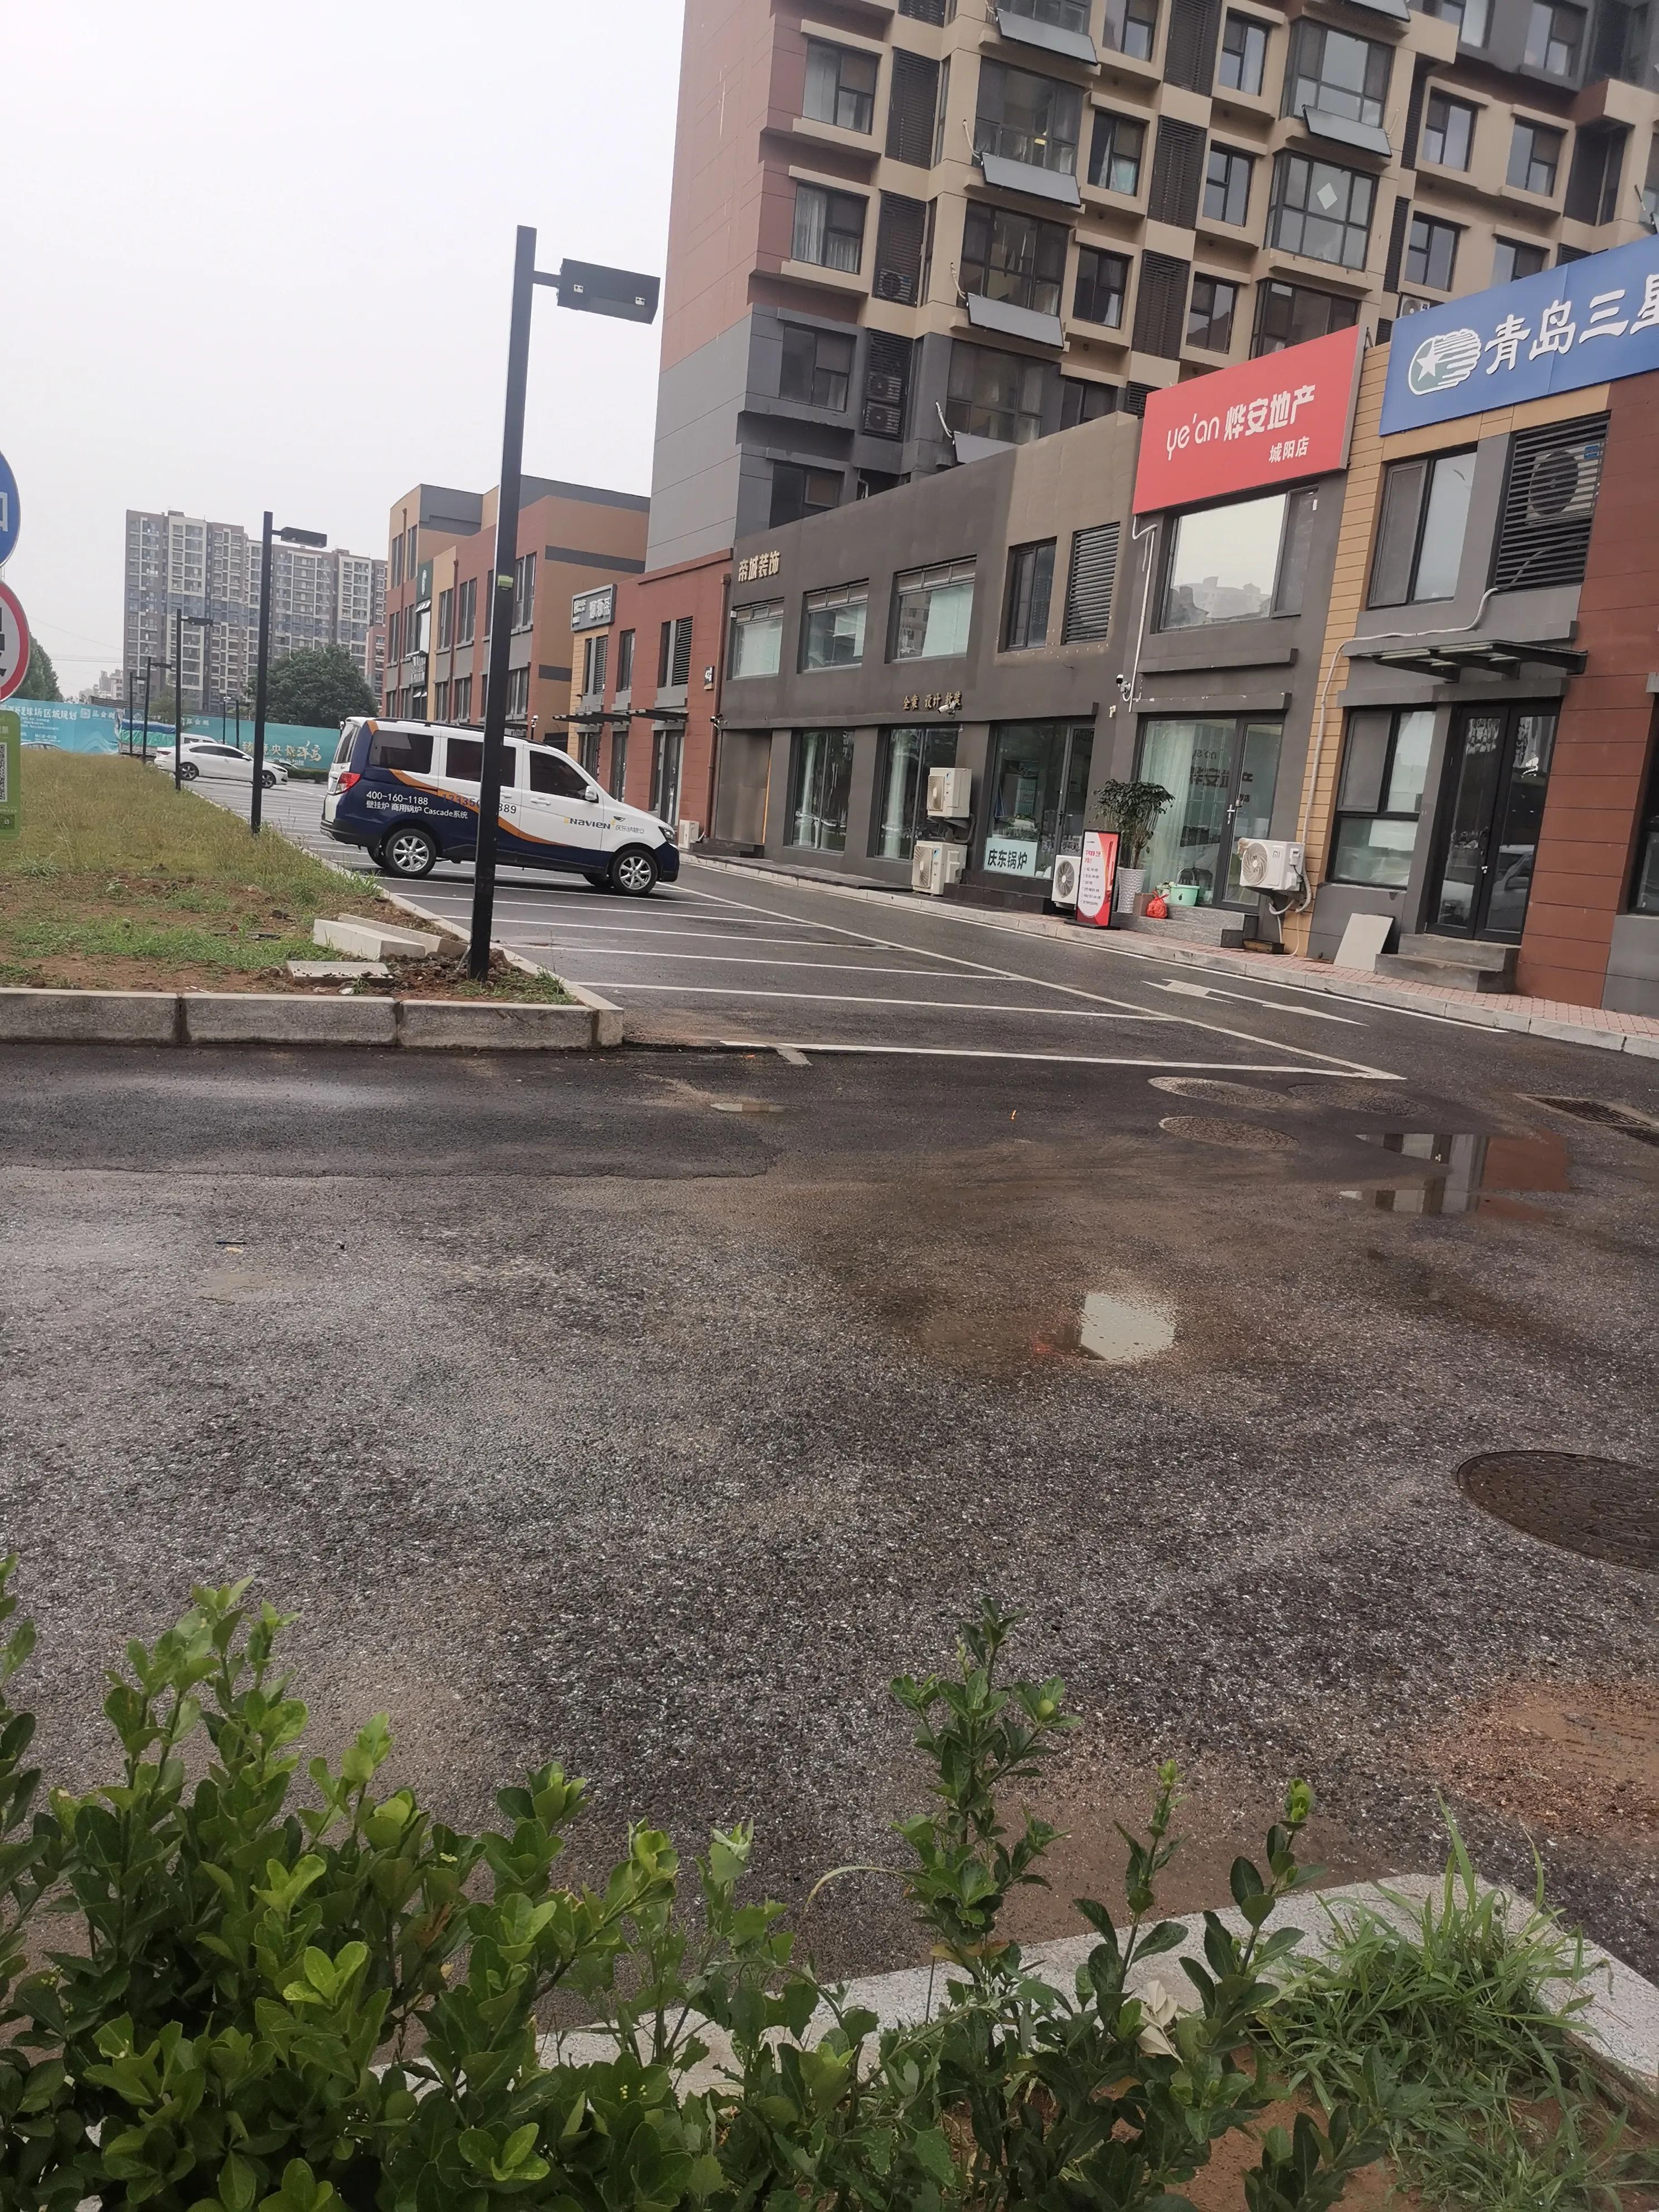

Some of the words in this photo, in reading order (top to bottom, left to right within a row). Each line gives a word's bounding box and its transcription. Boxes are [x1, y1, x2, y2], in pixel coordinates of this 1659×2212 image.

[1485, 274, 1659, 375] 青岛三星
[1167, 413, 1219, 460] ye'an
[1224, 384, 1316, 442] 烨安地产
[1269, 436, 1309, 463] 城阳店
[738, 550, 780, 582] 帝城装饰
[366, 790, 429, 806] 400-160-1188
[366, 800, 390, 810] 壁挂炉
[391, 803, 423, 814] 商用锅炉
[987, 848, 1028, 870] 庆东锅炉
